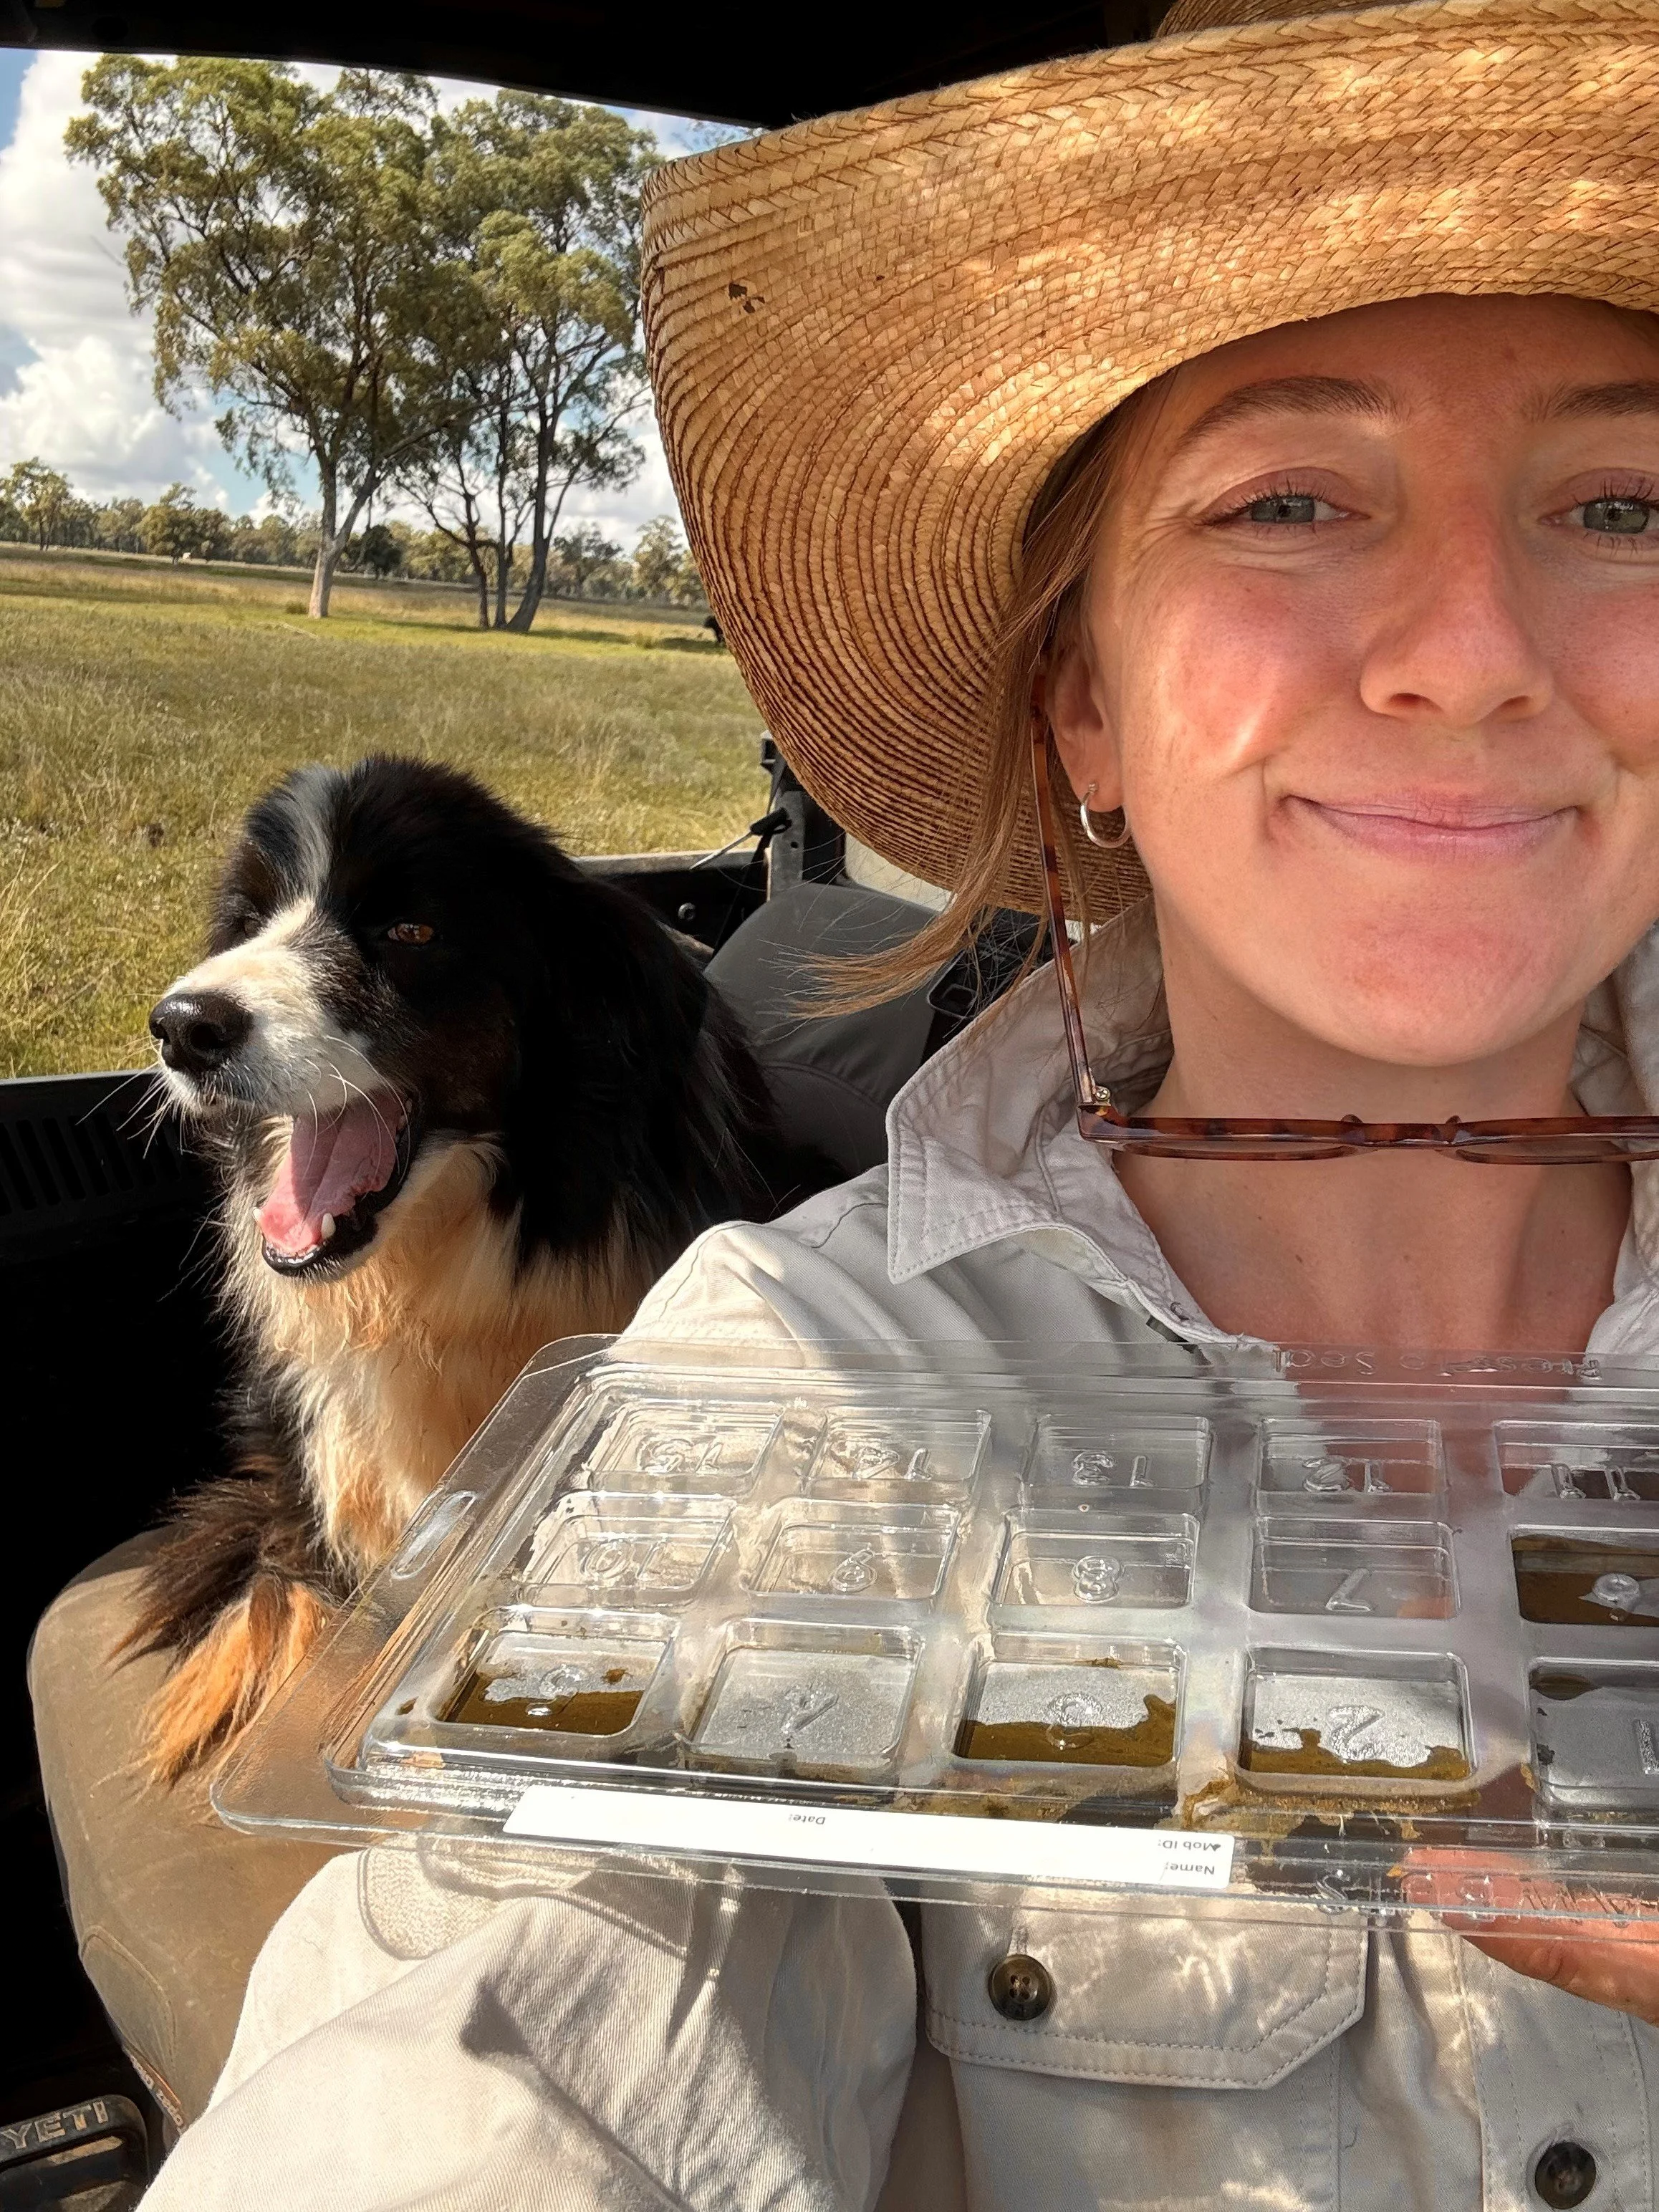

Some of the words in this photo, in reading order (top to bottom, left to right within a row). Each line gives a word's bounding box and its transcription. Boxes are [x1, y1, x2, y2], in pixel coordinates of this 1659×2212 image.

[1272, 1348, 1377, 1375] Seal
[1072, 1555, 1123, 1604] 8
[1324, 1567, 1372, 1613] 7
[789, 1814, 826, 1824] Date:
[1183, 1841, 1221, 1851] Mob
[1165, 1862, 1215, 1875] Name:
[0, 2100, 108, 2149] YETI
